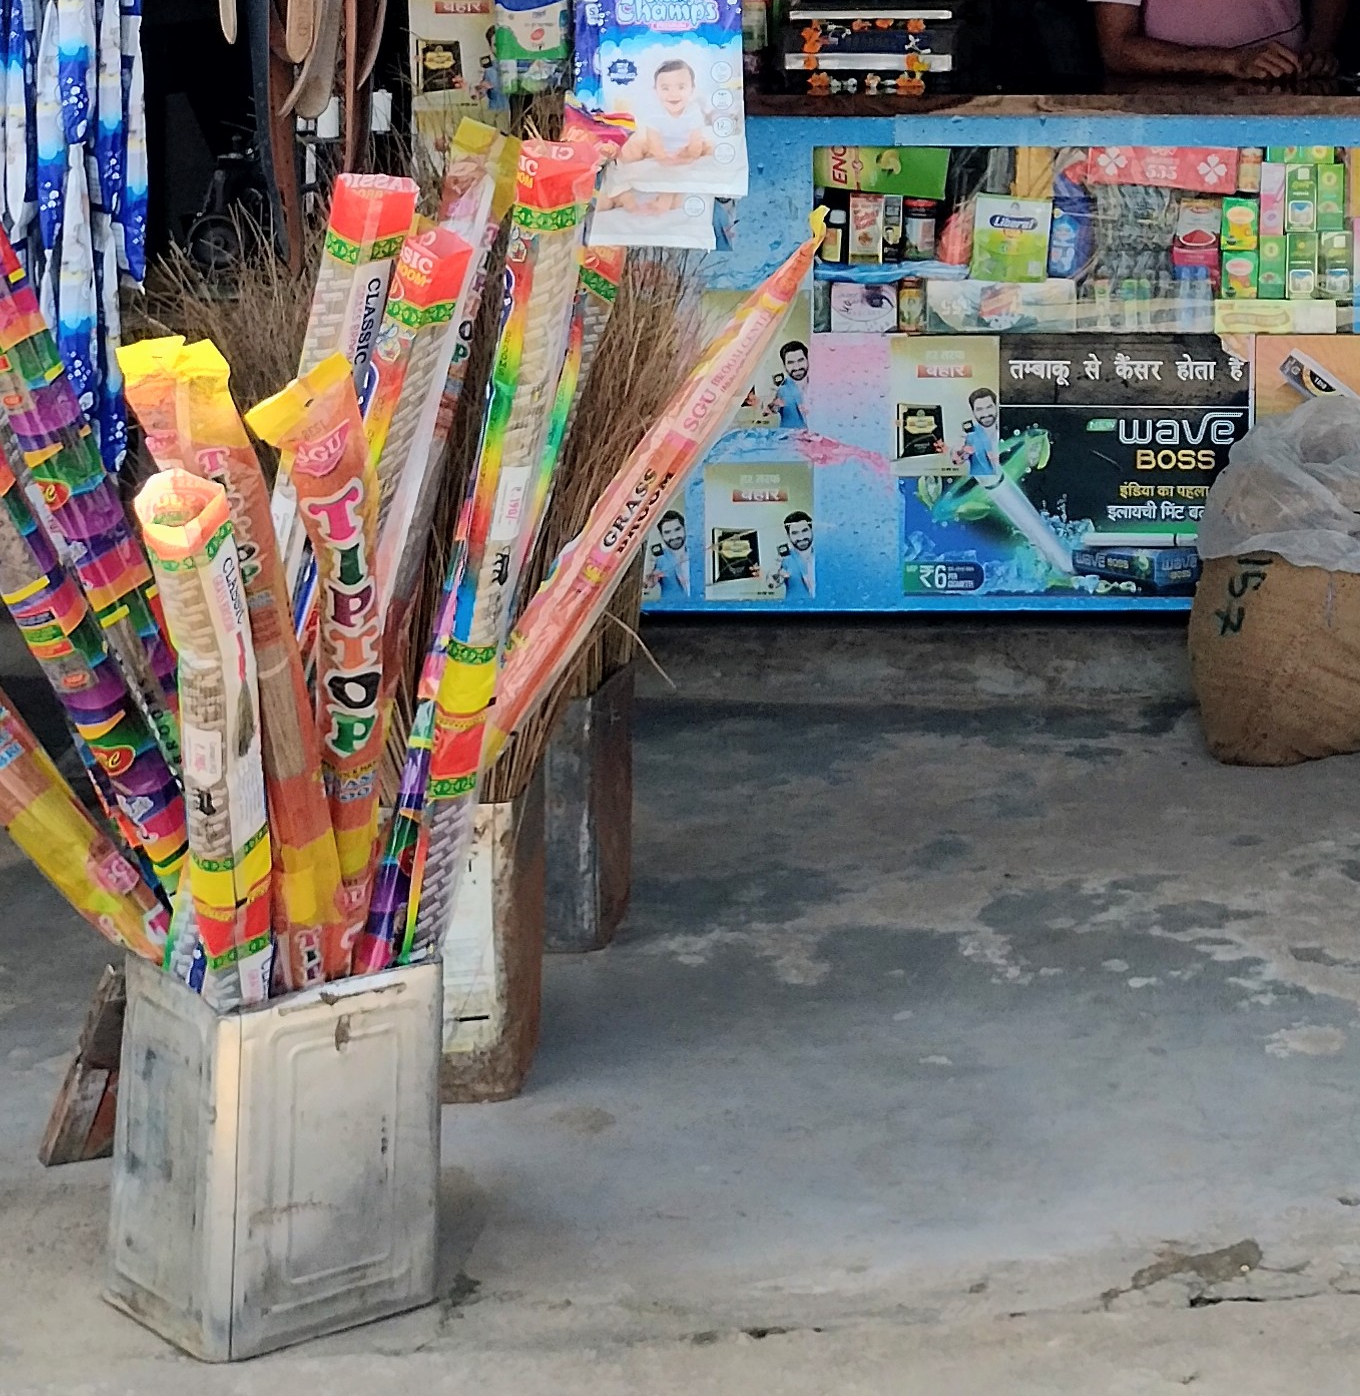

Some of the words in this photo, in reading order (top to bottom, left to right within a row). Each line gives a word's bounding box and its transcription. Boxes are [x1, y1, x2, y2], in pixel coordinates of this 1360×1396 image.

[352, 276, 382, 366] CLASSIC
[1008, 360, 1071, 386] तम्बाकू
[1083, 353, 1102, 381] से
[1113, 352, 1163, 382] कैंसर
[1175, 353, 1217, 382] होता
[1135, 449, 1216, 471] BOSS
[1119, 481, 1155, 499] इंडिया
[1157, 485, 1175, 498] का
[601, 465, 659, 550] GRASS
[1106, 500, 1158, 522] इलायची
